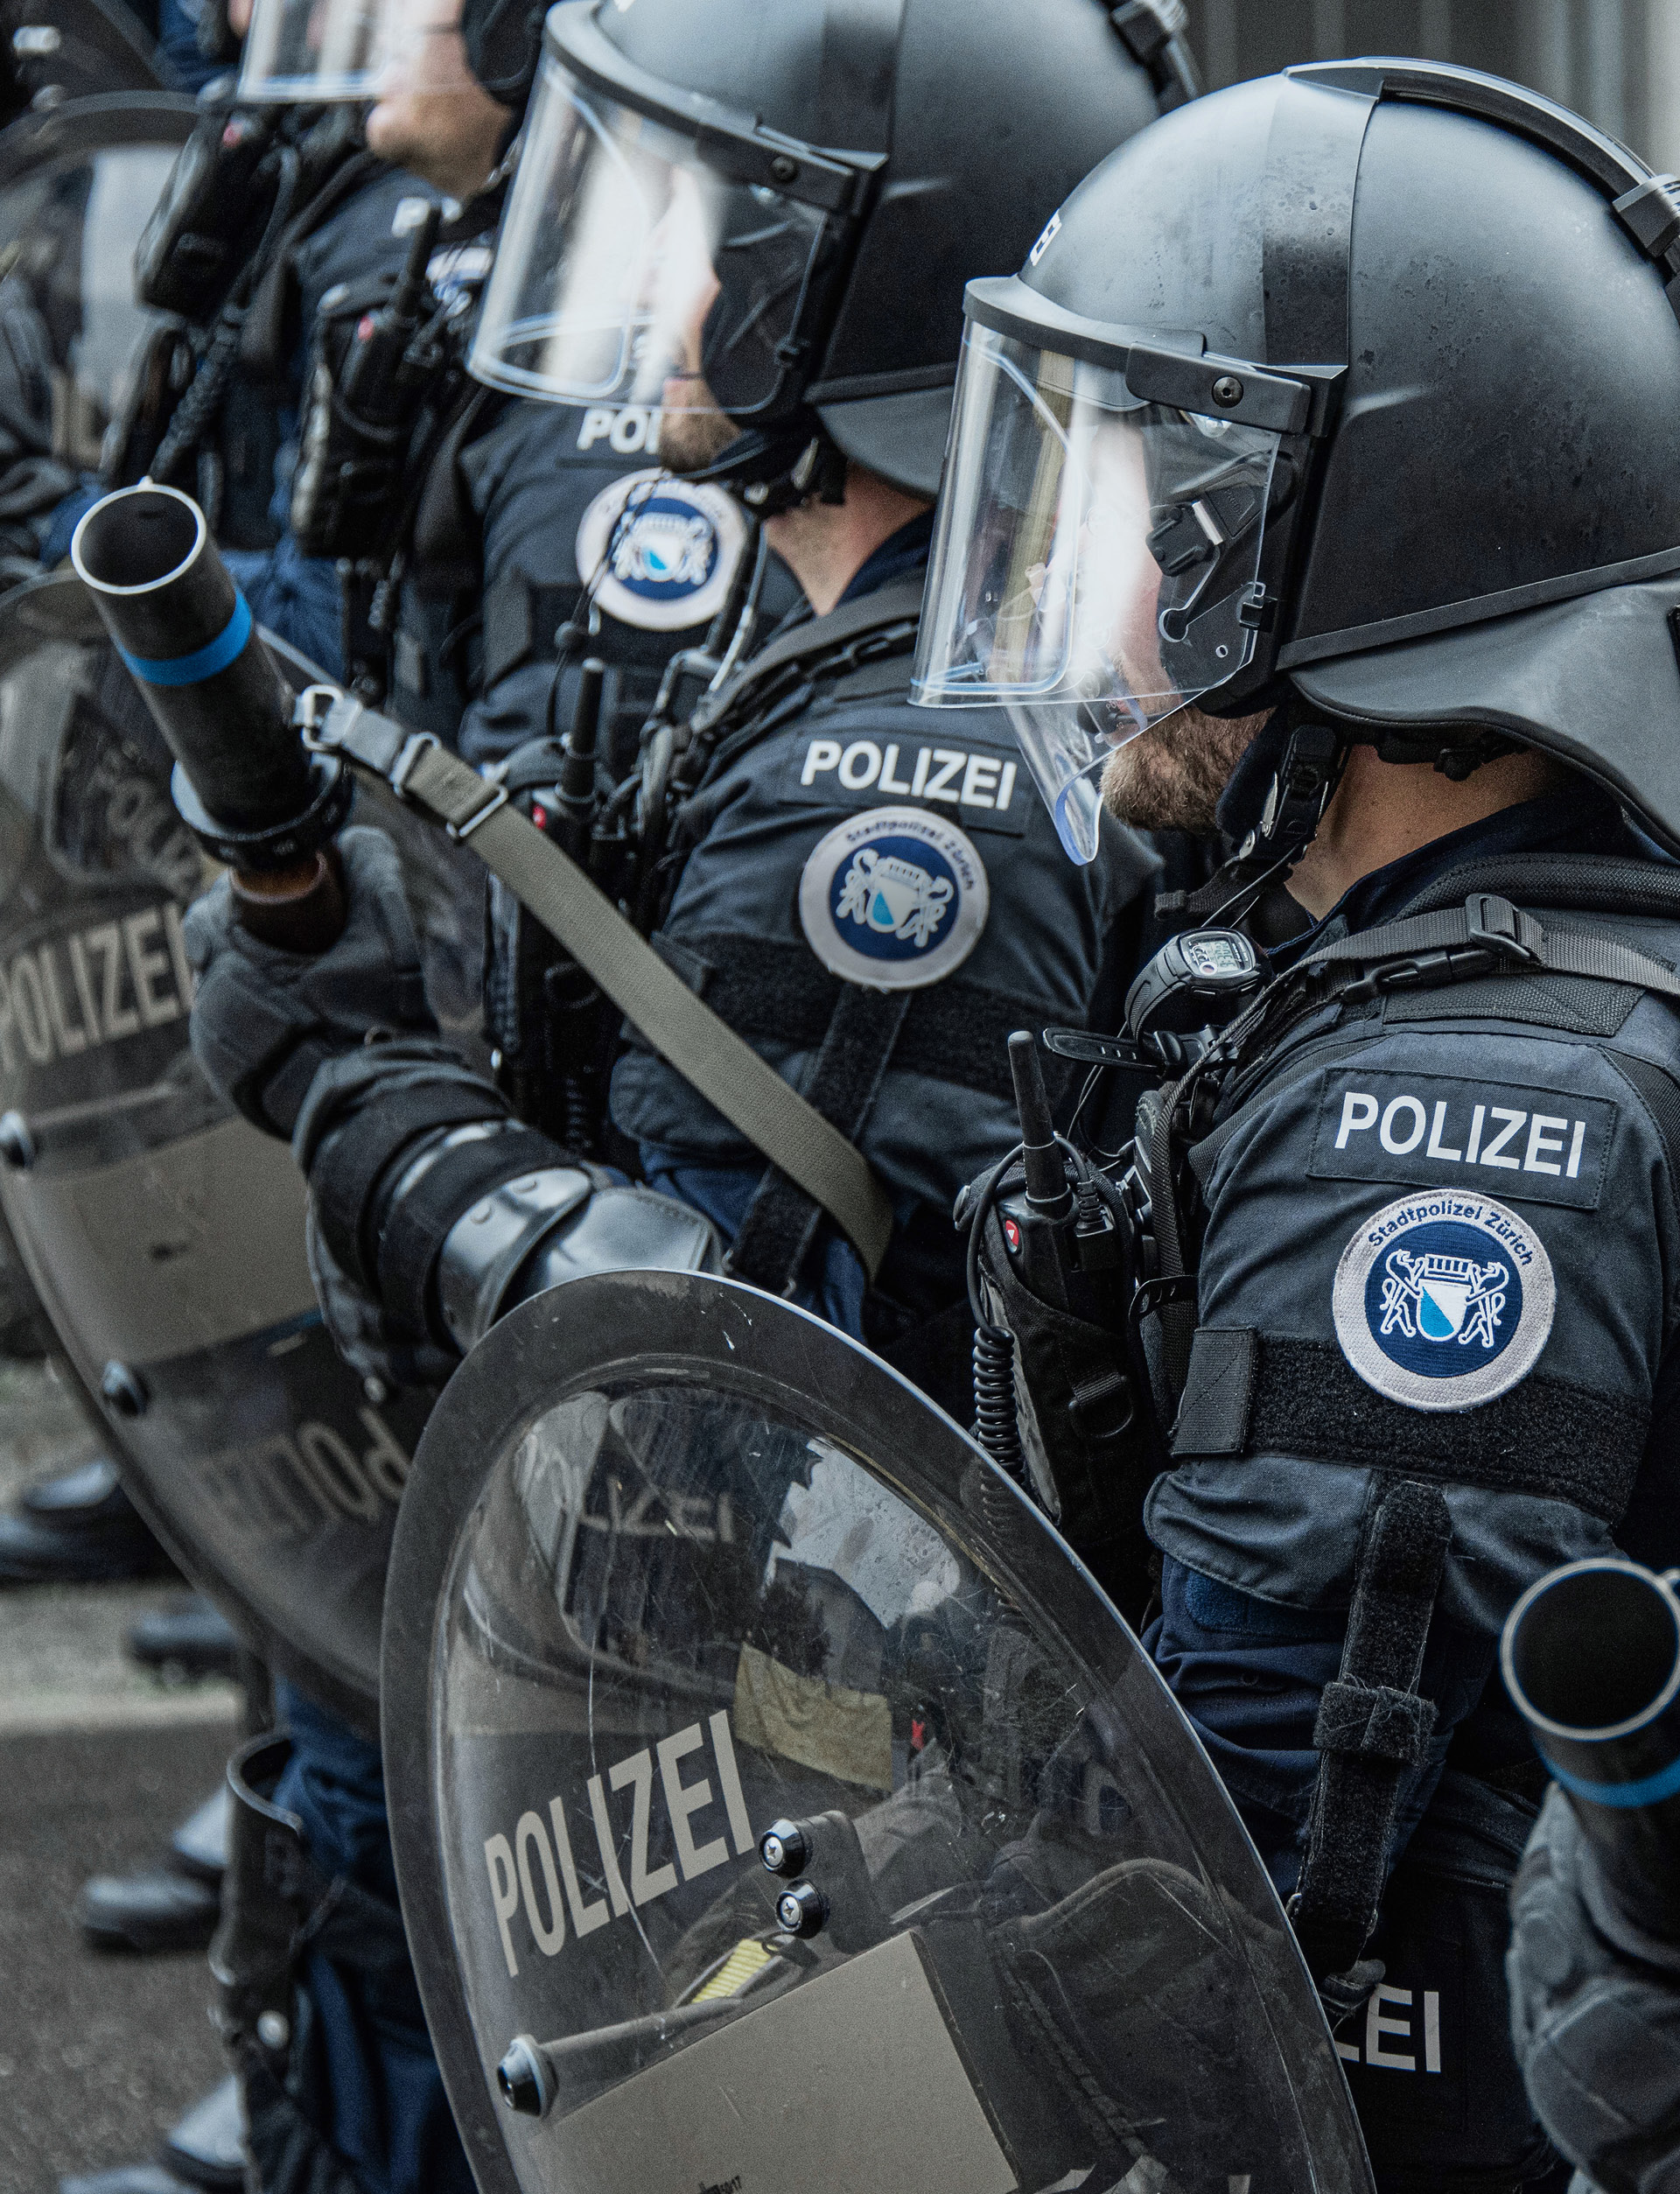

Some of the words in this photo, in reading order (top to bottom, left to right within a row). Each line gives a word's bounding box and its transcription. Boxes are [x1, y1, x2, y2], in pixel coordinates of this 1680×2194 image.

[800, 740, 1018, 810] POLIZEI
[1334, 1091, 1586, 1178] POLIZEI
[1368, 1200, 1482, 1247] Stadtpolizei
[1484, 1212, 1533, 1266] Zürich
[483, 1709, 755, 1978] POLIZEI
[1334, 1982, 1442, 2073] EI
